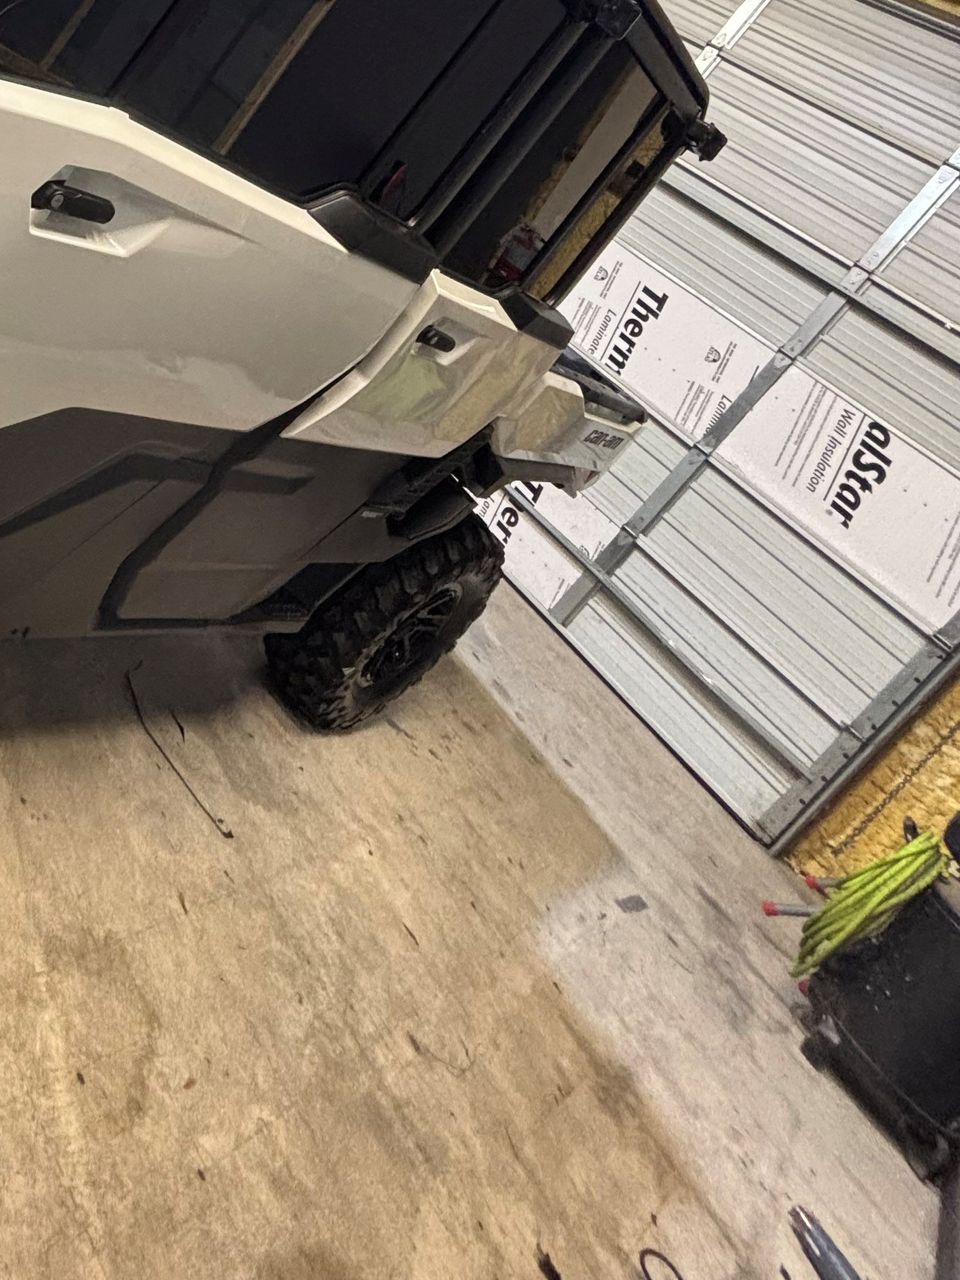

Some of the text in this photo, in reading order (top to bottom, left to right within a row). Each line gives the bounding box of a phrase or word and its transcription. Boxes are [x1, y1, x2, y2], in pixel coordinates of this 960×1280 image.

[589, 308, 617, 355] Laminate
[583, 429, 624, 450] can-am
[833, 408, 857, 438] Wall
[806, 435, 842, 493] Insulation
[497, 481, 544, 546] Ther
